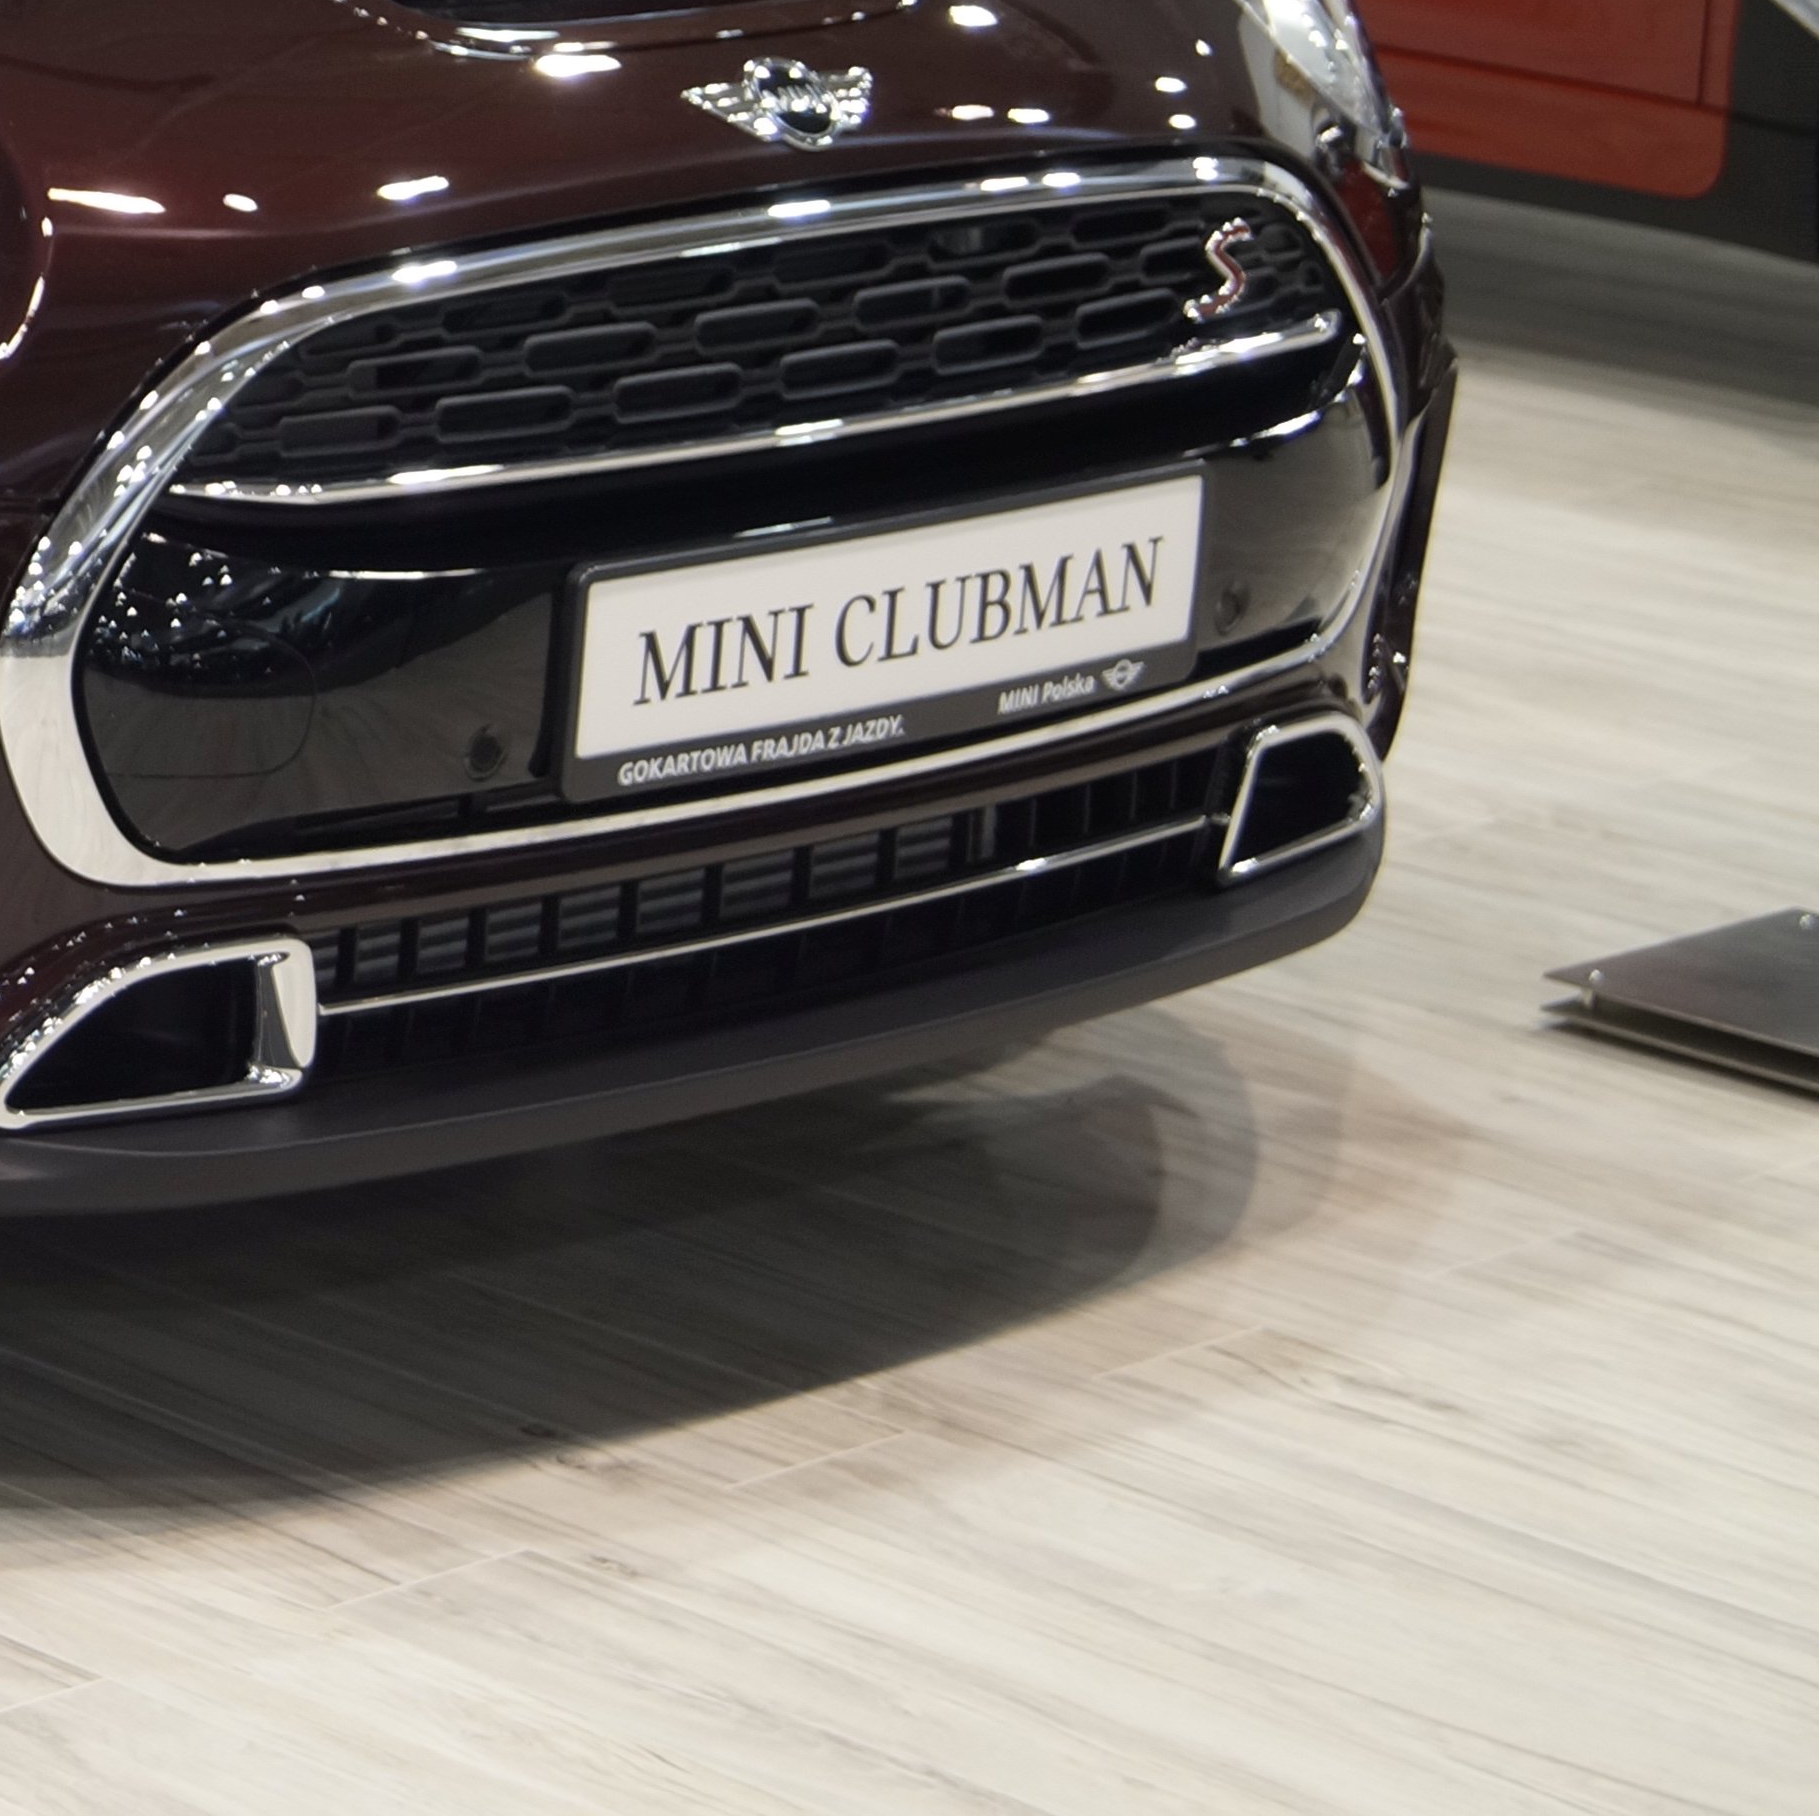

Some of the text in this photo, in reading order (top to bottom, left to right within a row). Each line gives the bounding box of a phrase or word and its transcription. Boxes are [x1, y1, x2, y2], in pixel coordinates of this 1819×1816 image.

[1183, 217, 1252, 323] S
[632, 537, 1164, 706] MINI CLUBMAN
[997, 672, 1096, 715] MINI Polska
[617, 714, 905, 786] GOKARTOWA FRAJDA Z JAZDY.
